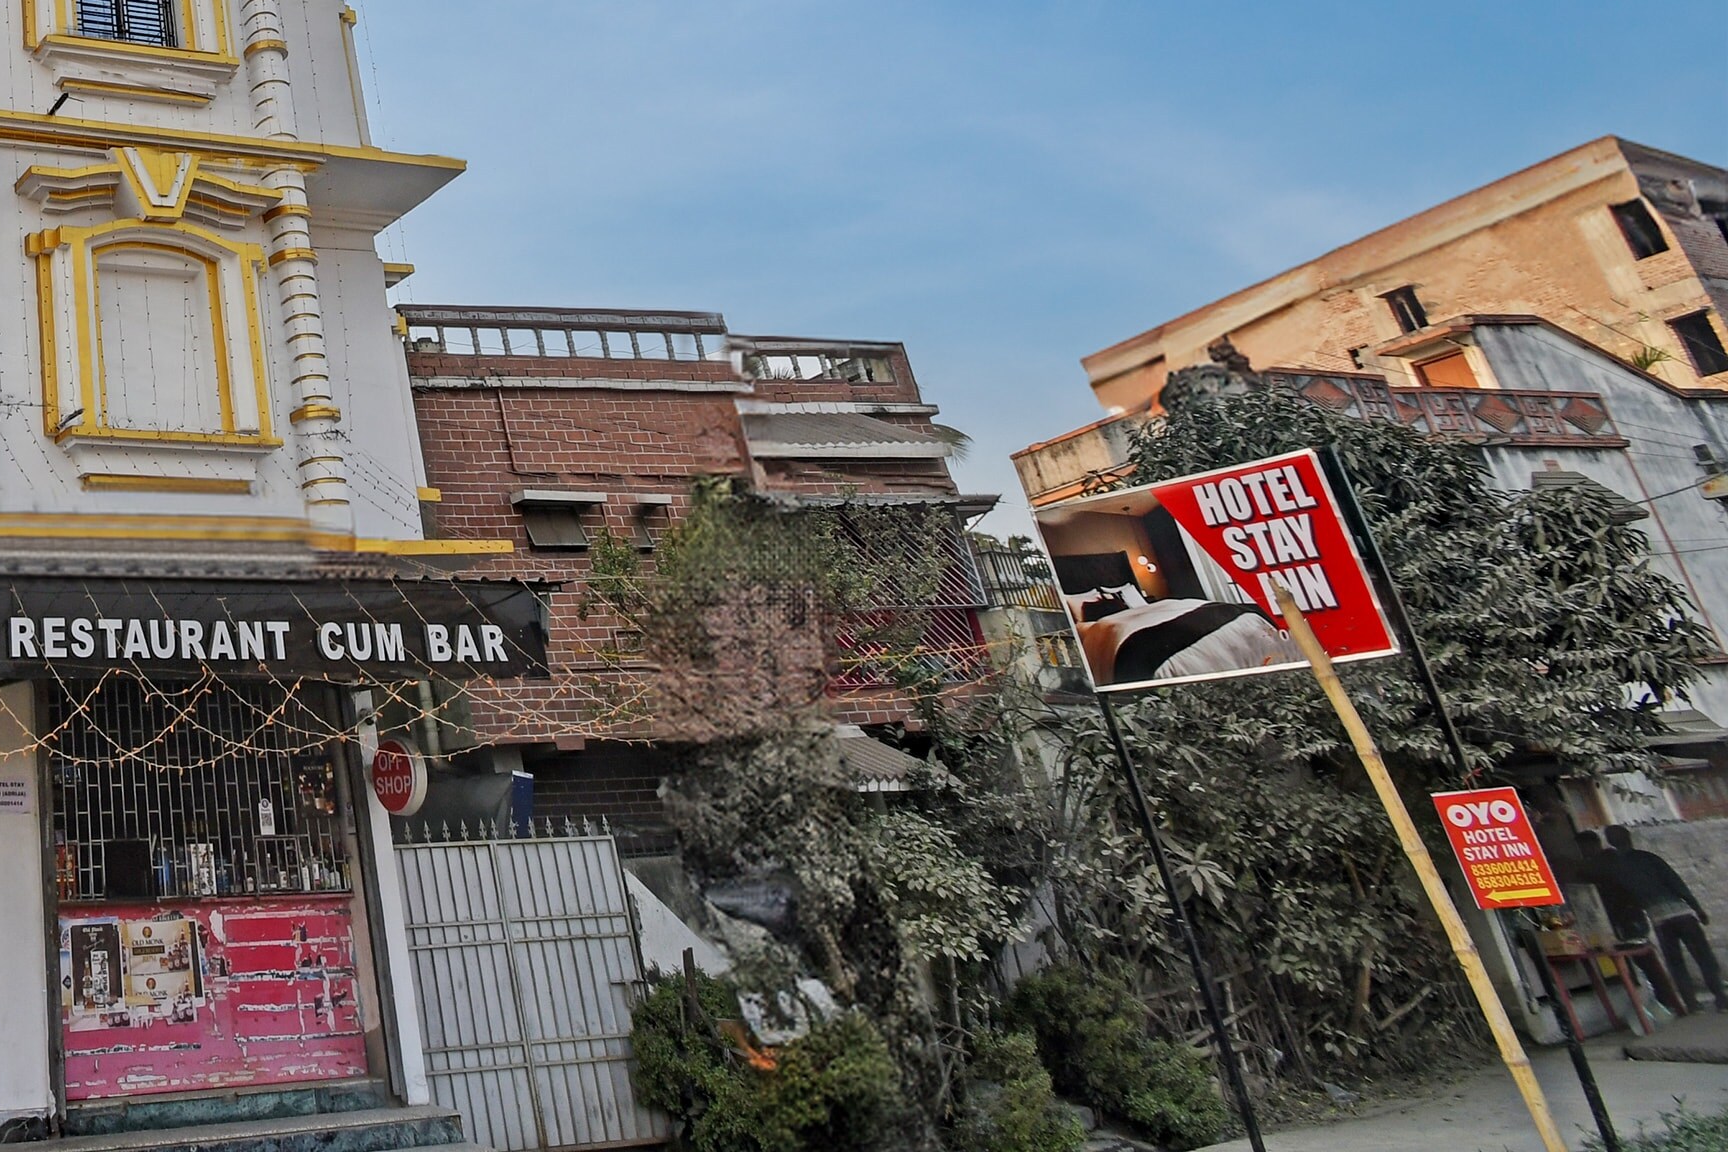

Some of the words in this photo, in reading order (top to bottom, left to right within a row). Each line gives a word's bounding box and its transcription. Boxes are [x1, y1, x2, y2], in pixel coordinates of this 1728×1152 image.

[1191, 464, 1318, 527] HOTEL
[1221, 513, 1321, 571] STAY
[9, 616, 291, 661] RESTAURANT
[319, 622, 406, 663] CUM
[428, 622, 509, 663] BAR
[378, 753, 402, 771] OFF
[376, 775, 411, 795] SHOP
[1446, 800, 1516, 828] OYO
[1462, 827, 1518, 845] HOTEL
[1463, 846, 1499, 862] STAY
[1501, 842, 1532, 858] INN
[1471, 859, 1539, 876] 8336001414
[1476, 872, 1546, 889] 8583045161
